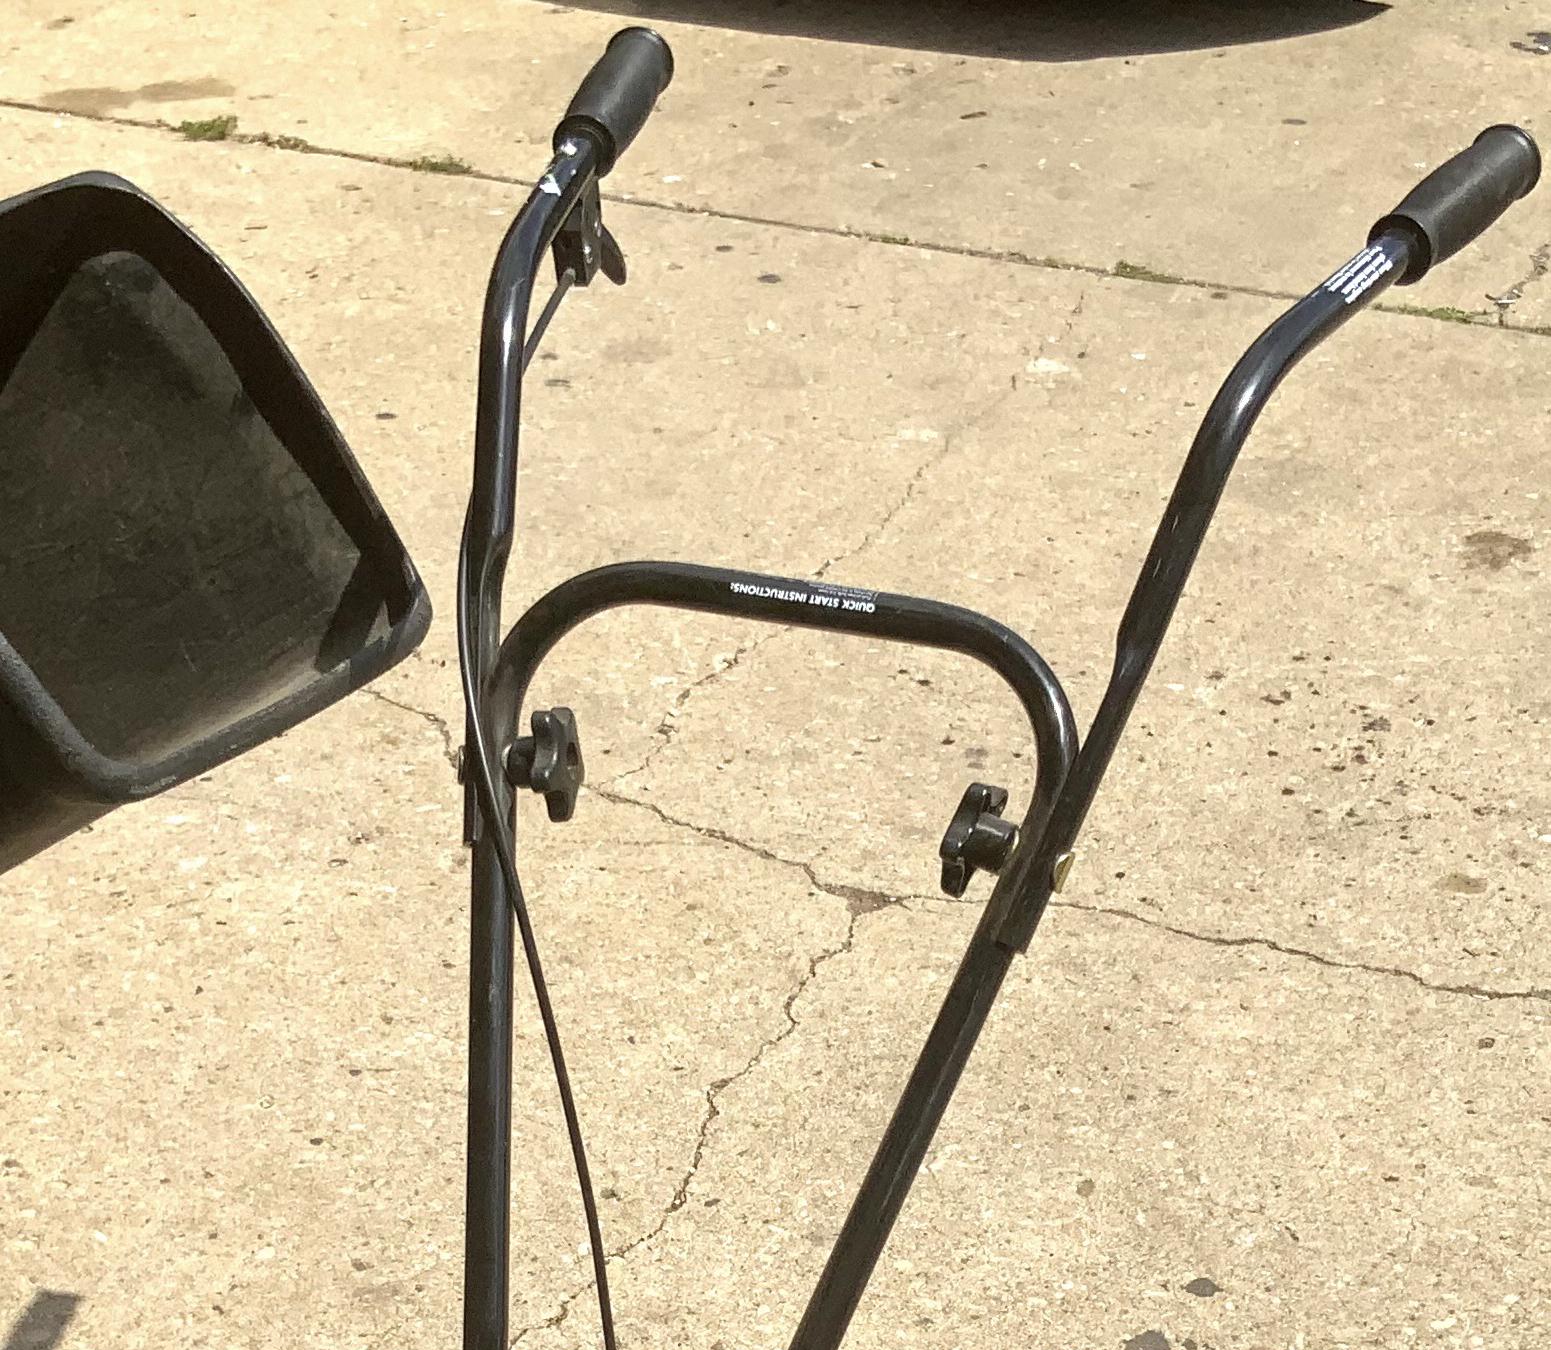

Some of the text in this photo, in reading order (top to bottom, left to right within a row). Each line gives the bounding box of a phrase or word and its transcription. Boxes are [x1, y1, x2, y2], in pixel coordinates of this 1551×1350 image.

[730, 583, 807, 602] INSTRUCTIONS:
[808, 594, 840, 607] START
[842, 599, 875, 613] QUICK
